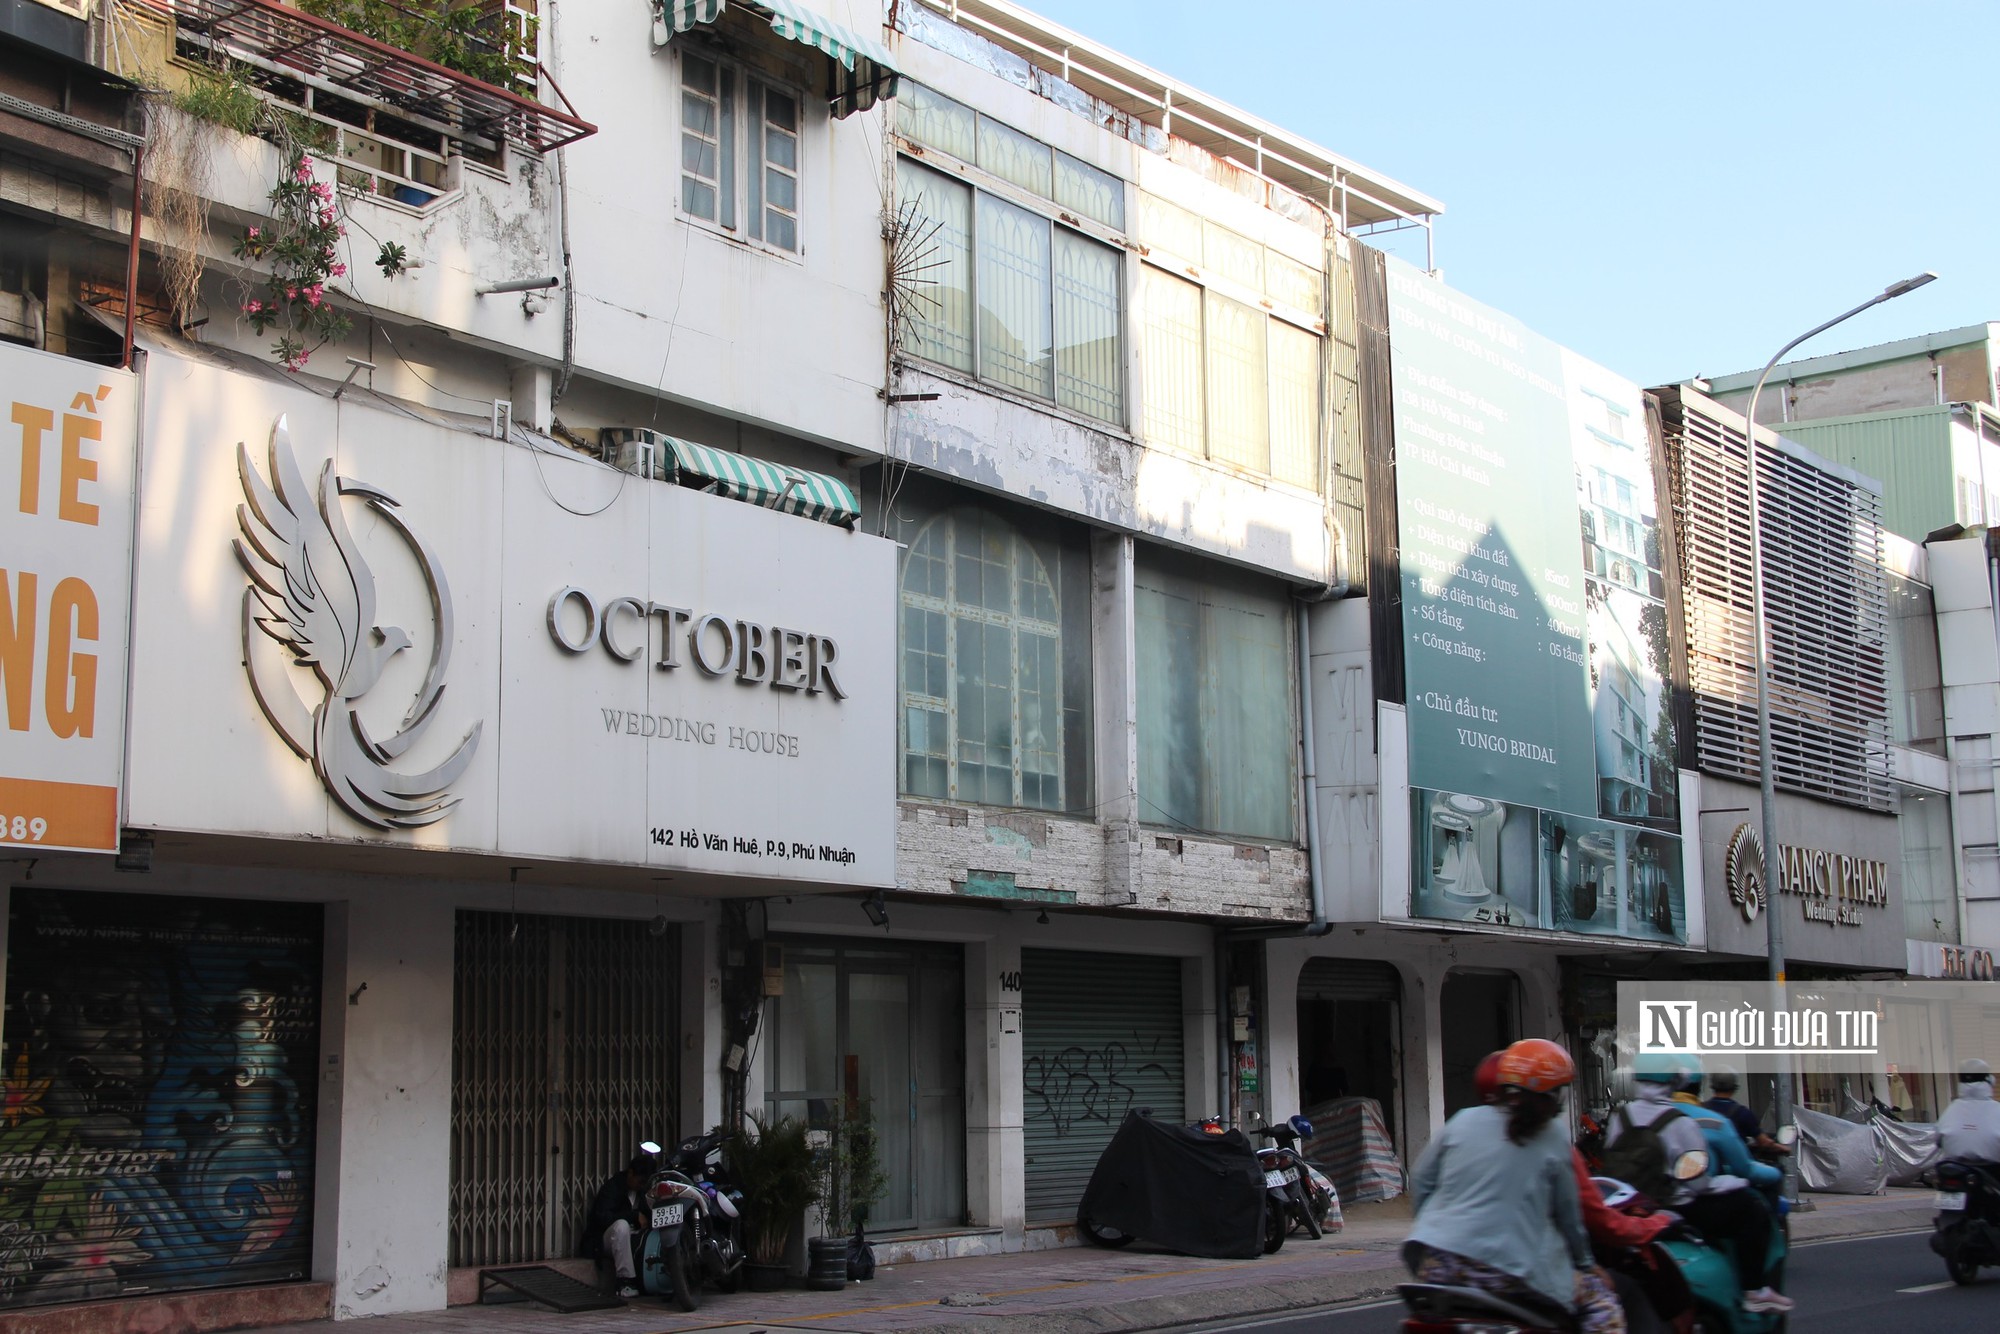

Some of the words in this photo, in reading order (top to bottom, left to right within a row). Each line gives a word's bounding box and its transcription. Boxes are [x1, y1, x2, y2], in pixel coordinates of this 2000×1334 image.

[12, 384, 112, 526] TẾ
[1420, 447, 1438, 466] Hồ
[1439, 456, 1460, 475] Chí
[1461, 463, 1490, 487] Minh
[1414, 498, 1435, 517] Qui
[1437, 506, 1456, 525] mô
[1457, 511, 1472, 530] dự
[1417, 524, 1444, 546] Diện
[1447, 533, 1468, 554] tích
[1469, 540, 1491, 561] khu
[1492, 548, 1509, 567] đất
[1418, 551, 1446, 573] Diện
[1447, 560, 1469, 580] tích
[1470, 569, 1489, 588] xây
[1419, 576, 1448, 602] Tổng
[1450, 586, 1474, 609] diện
[1475, 594, 1497, 614] tích
[1421, 603, 1435, 621] Số
[546, 585, 849, 701] OCTOBER
[1547, 617, 1581, 640] 400m2
[1422, 631, 1451, 654] Công
[1454, 641, 1481, 663] năng
[1549, 642, 1561, 657] 05
[1562, 644, 1584, 666] tầng
[1424, 692, 1452, 713] Chủ
[1455, 697, 1479, 719] đầu
[601, 707, 716, 745] WEDDING
[728, 725, 800, 758] HOUSE
[1457, 728, 1507, 753] YUNGO
[1510, 739, 1556, 764] BRIDAL
[650, 827, 674, 847] 142
[680, 829, 699, 849] Hồ
[703, 833, 728, 852] Văn
[819, 845, 856, 867] Nhuận
[1776, 844, 1835, 898] NANCY
[1838, 854, 1890, 907] PHAM
[1803, 900, 1837, 926] Wedding
[1841, 905, 1864, 926] Studio
[999, 971, 1022, 992] 140
